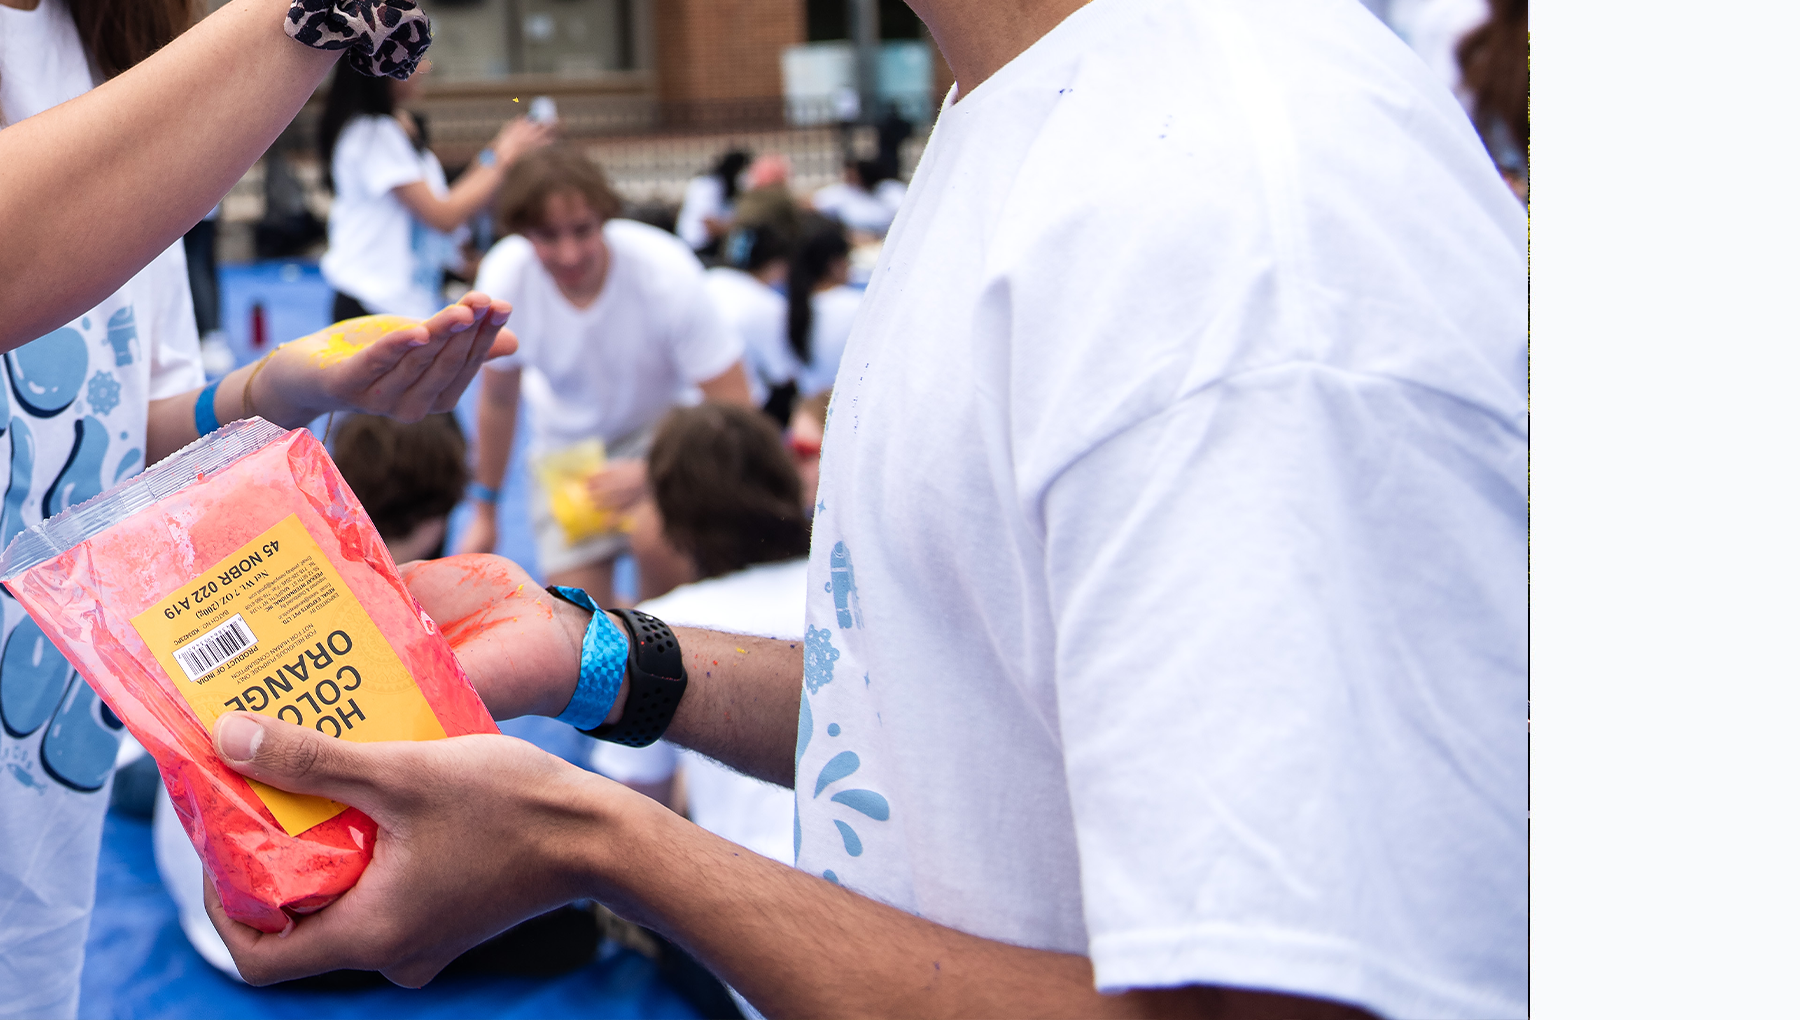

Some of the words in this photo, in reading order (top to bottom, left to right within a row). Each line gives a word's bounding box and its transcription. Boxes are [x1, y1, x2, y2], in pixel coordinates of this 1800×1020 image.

[262, 540, 279, 558] 45
[217, 551, 263, 586] NOBR
[253, 569, 269, 582] Net
[190, 581, 219, 604] 022
[234, 589, 241, 597] 7
[239, 580, 255, 590] Wt.
[219, 592, 234, 605] OZ
[272, 582, 307, 606] INTERNATIONAL
[285, 590, 307, 606] Distributed
[315, 592, 340, 611] EXPORTED
[164, 596, 191, 620] A19
[195, 600, 220, 620] (200g)
[300, 596, 322, 613] EXPORTS
[210, 609, 230, 623] BATCH
[289, 631, 302, 642] FOR
[302, 623, 314, 634] NOT
[304, 629, 317, 640] FOR
[269, 639, 290, 655] HUMAN
[275, 637, 305, 659] RELIGIOUS
[226, 645, 259, 670] PRODUCT
[231, 652, 271, 679] CONSUMPTION
[216, 666, 226, 676] OF
[250, 656, 277, 676] PURPOSE
[196, 672, 216, 685] INDIA
[224, 630, 353, 719] ORANGE
[237, 673, 251, 685] ONLY
